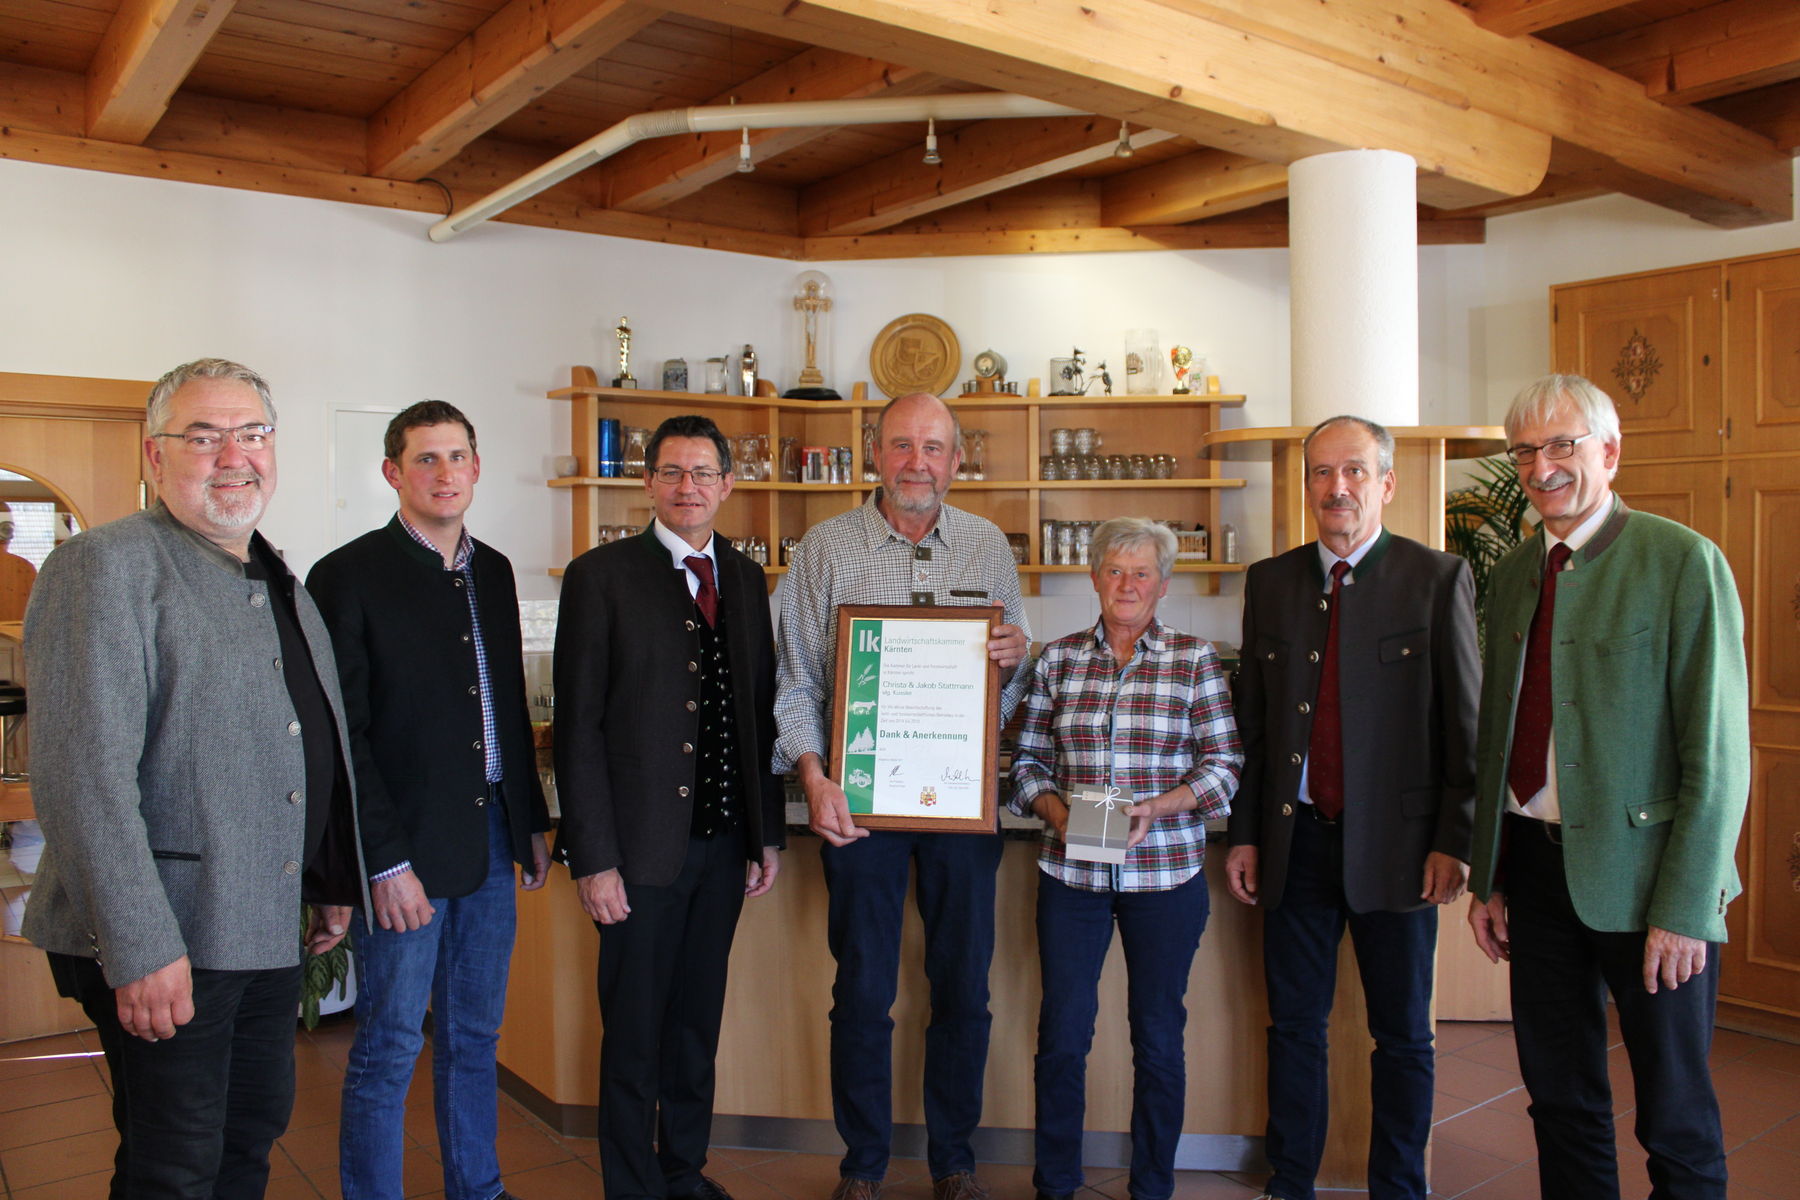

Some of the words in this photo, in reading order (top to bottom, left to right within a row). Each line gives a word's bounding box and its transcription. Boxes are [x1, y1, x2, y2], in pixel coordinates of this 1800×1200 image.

[859, 630, 880, 653] lk
[884, 637, 966, 646] Landwirtschaftskammer
[884, 645, 913, 653] Kärnten
[882, 681, 907, 689] Christa
[908, 681, 915, 689] &
[916, 681, 937, 689] Jakob
[938, 682, 974, 690] Stattmann
[879, 730, 901, 739] Dank
[903, 730, 910, 739] &
[912, 731, 968, 742] Anerkennung
